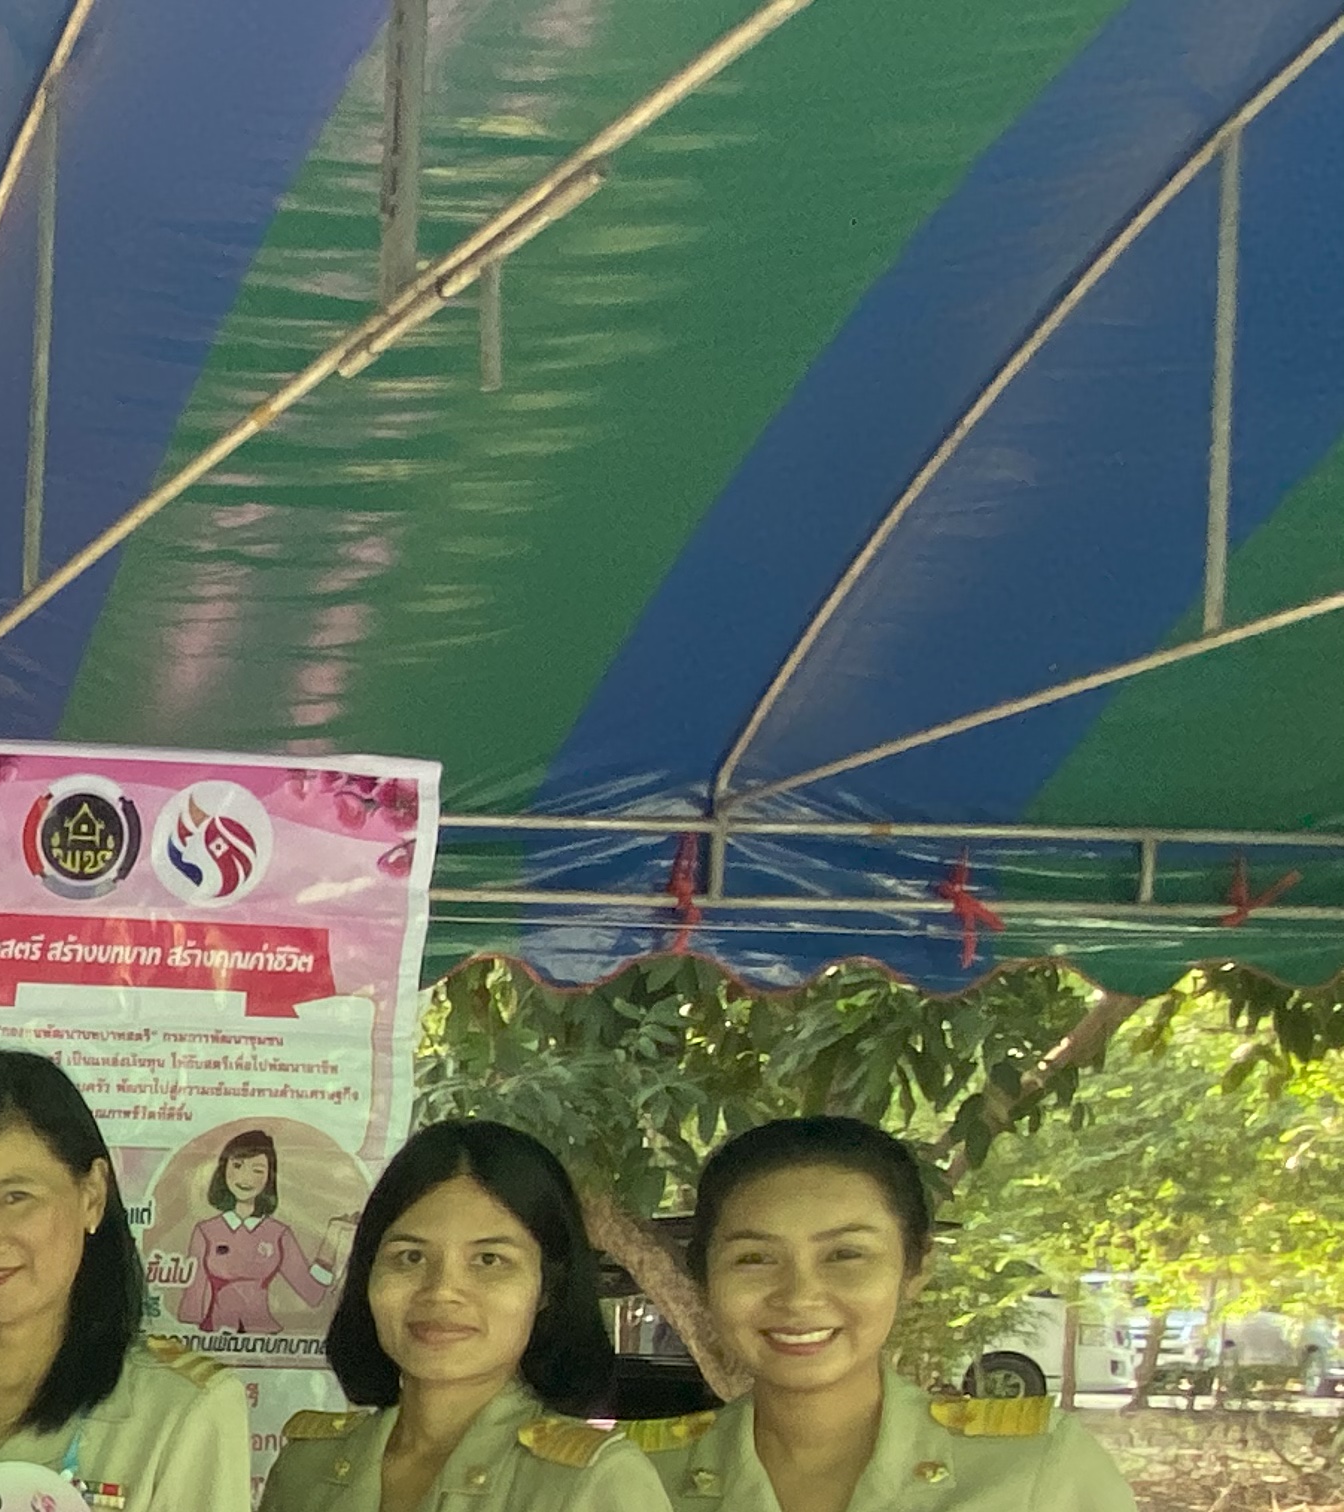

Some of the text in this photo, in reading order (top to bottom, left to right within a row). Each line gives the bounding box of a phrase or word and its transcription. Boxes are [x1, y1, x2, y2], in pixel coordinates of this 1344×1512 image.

[47, 938, 162, 968] สร้างบทบาท
[166, 944, 315, 980] สร้างคุณค่าชีวิต
[146, 1256, 194, 1285] ขึ้นไป
